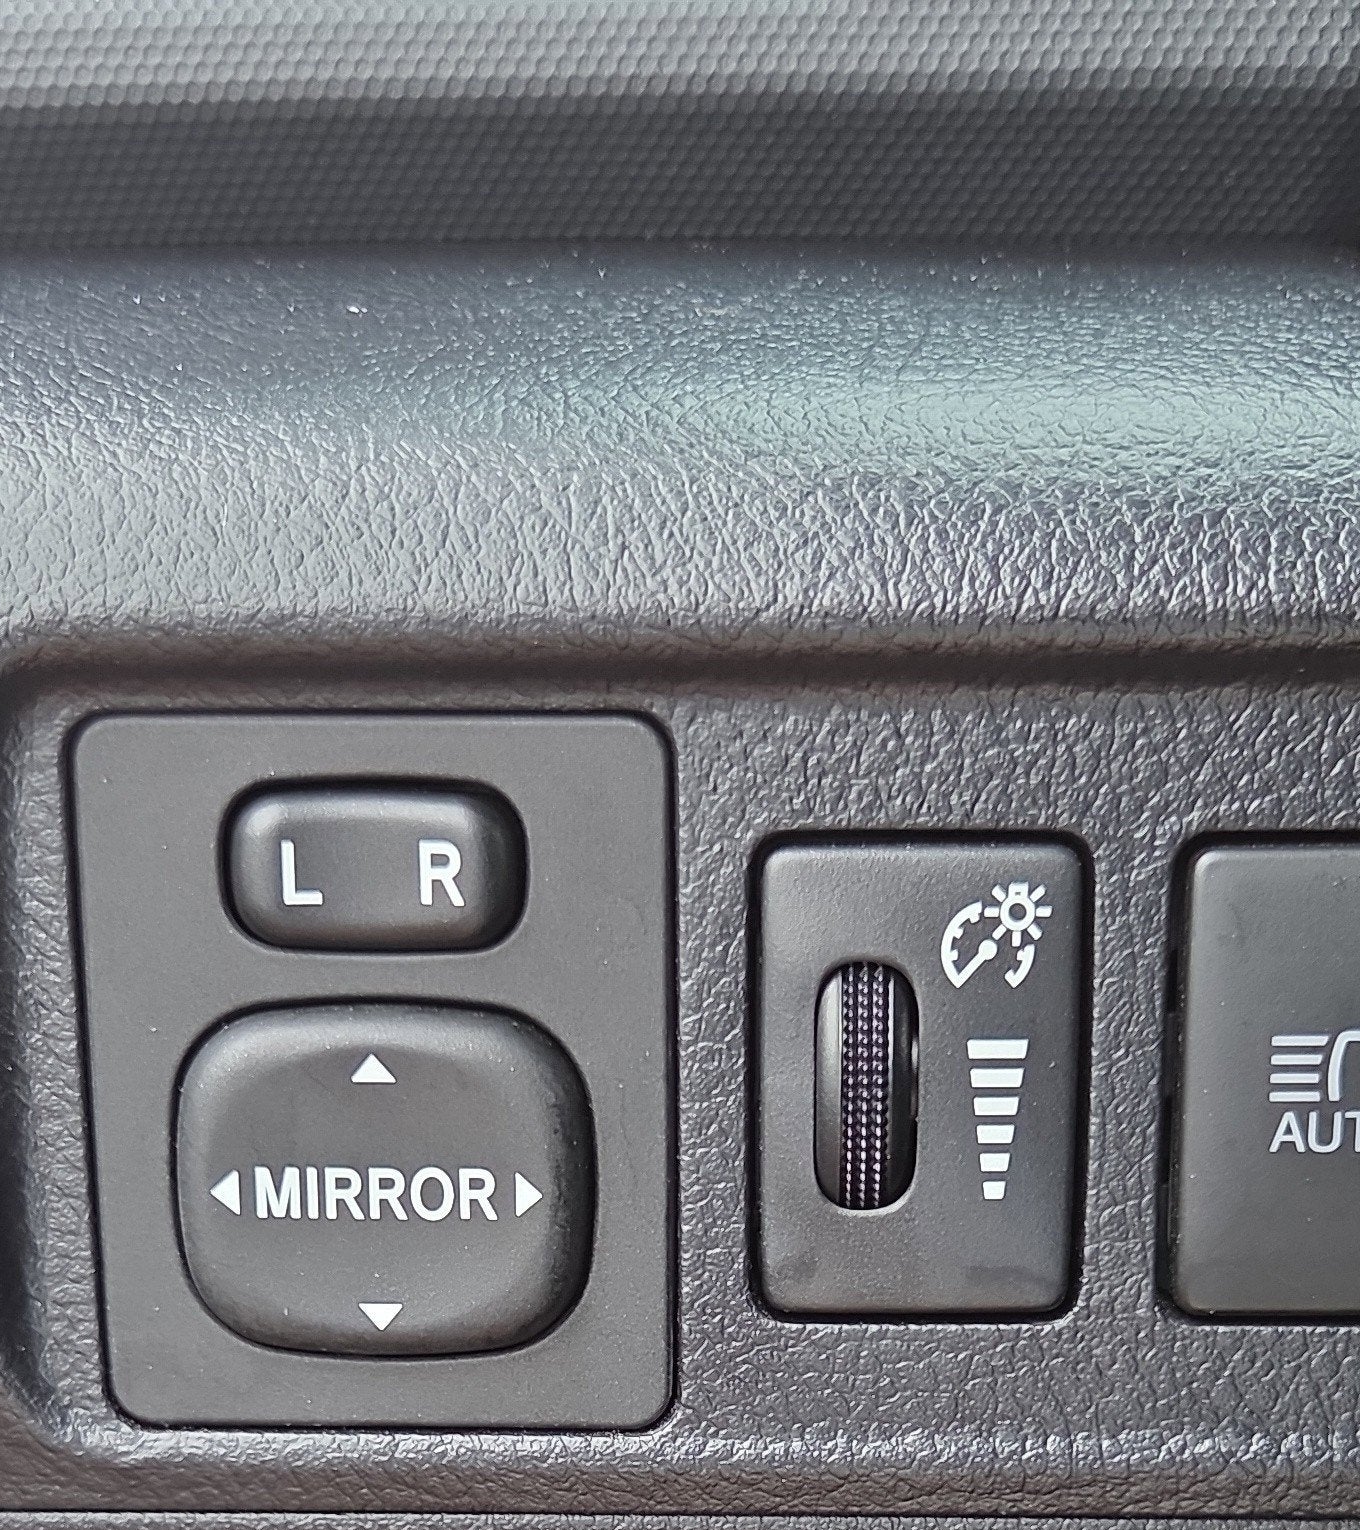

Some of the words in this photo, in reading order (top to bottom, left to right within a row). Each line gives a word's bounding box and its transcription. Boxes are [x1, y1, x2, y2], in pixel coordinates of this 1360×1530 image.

[280, 839, 323, 906] L
[418, 839, 465, 907] R
[254, 1166, 498, 1222] MIRROR
